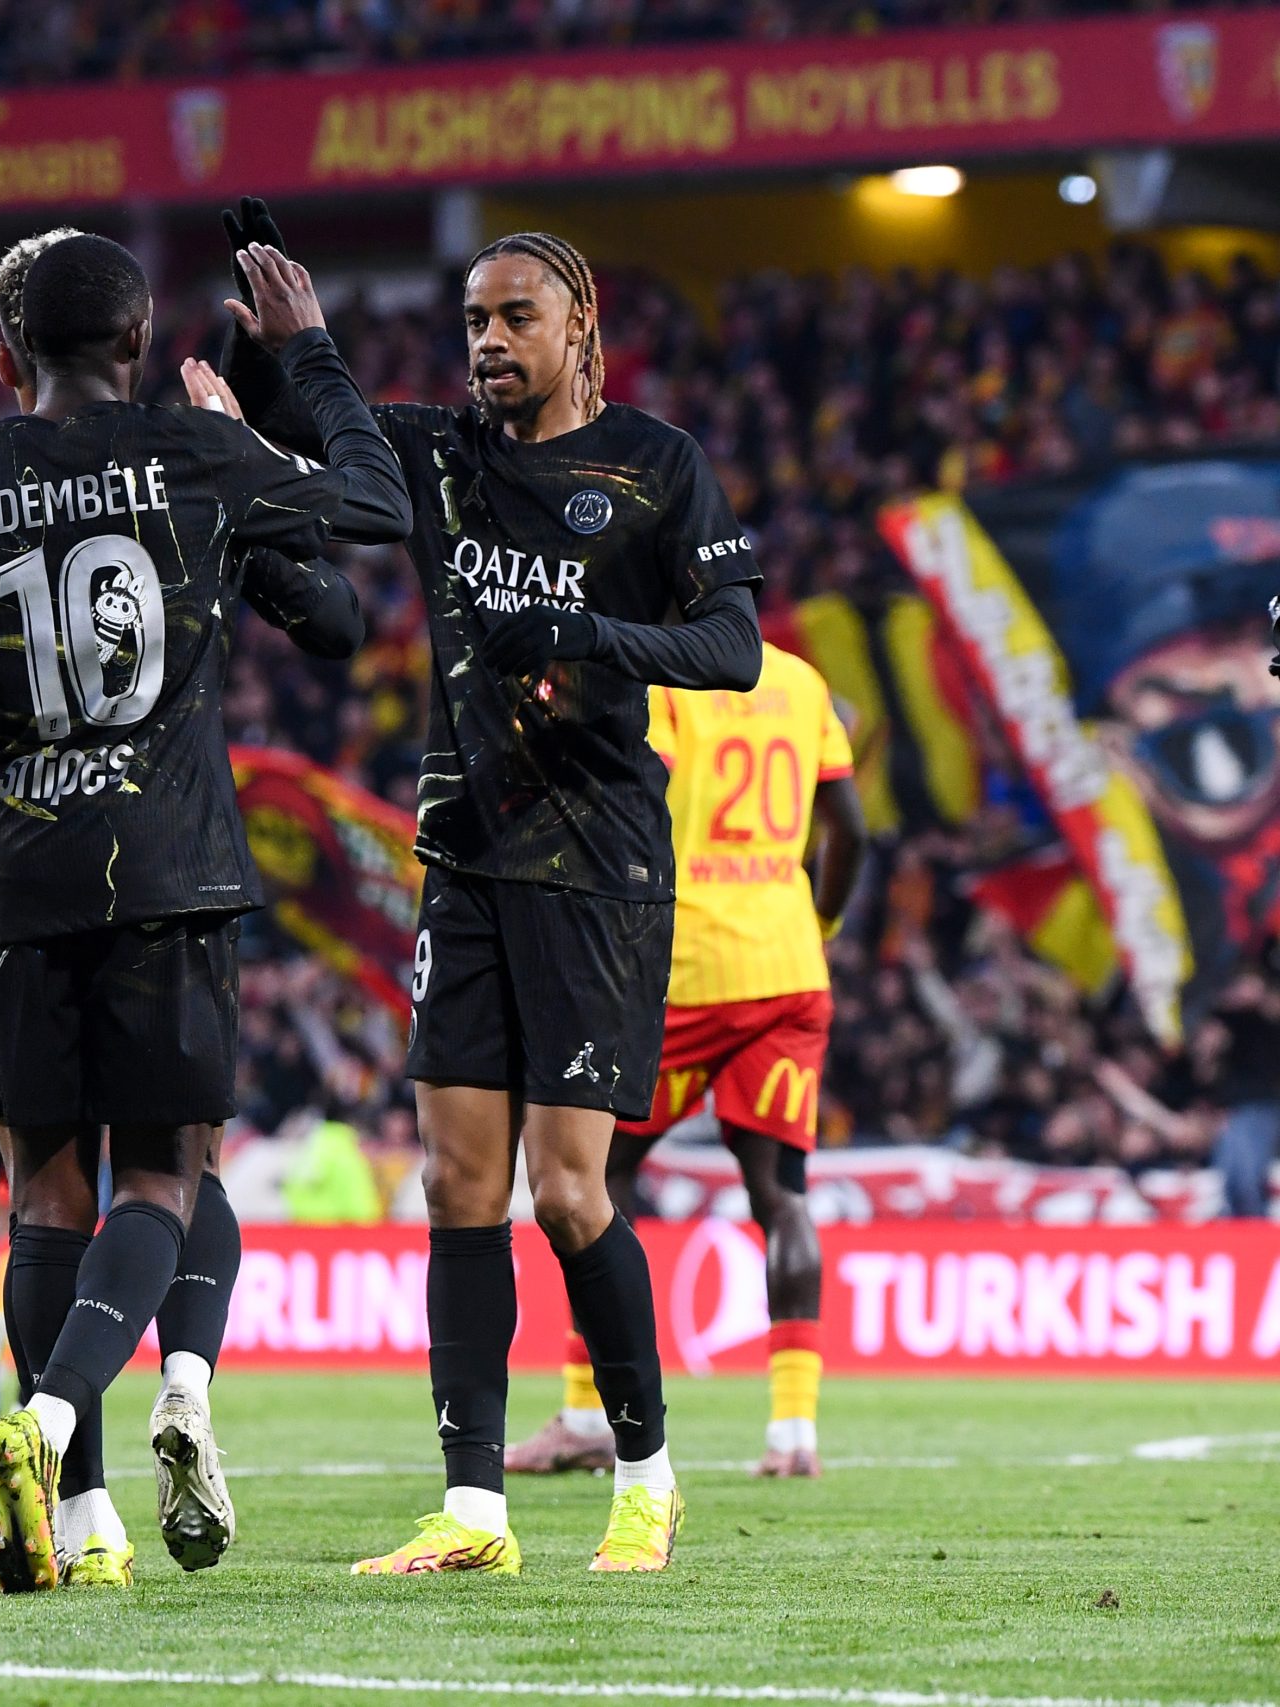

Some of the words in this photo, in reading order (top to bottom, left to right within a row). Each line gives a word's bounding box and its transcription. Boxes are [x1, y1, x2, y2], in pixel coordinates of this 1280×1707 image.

[745, 49, 1061, 134] NOYELLES
[454, 539, 586, 599] QATAR
[709, 736, 801, 842] 20
[75, 1299, 125, 1322] PARIS
[839, 1251, 1236, 1358] TURKISH
